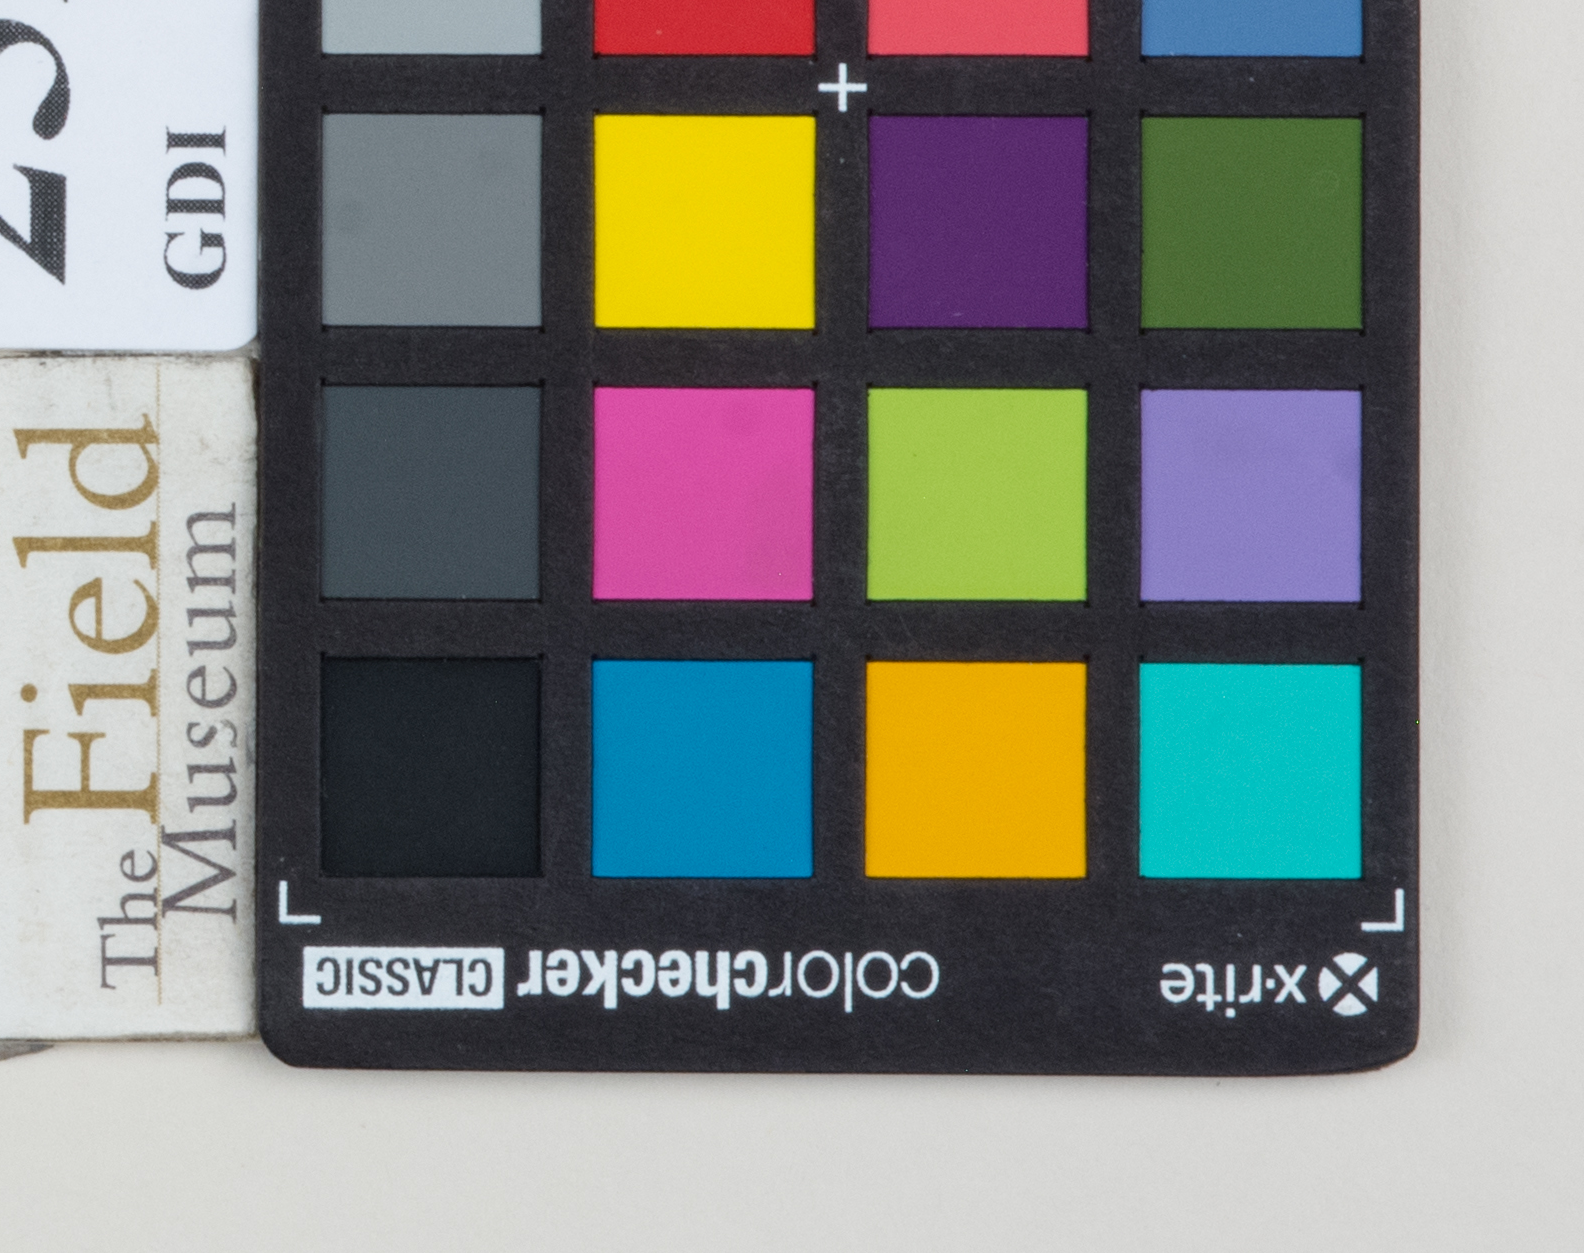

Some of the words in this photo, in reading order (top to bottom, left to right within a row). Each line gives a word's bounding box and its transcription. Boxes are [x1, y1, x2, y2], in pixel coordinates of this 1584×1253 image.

[163, 125, 228, 291] GDI
[12, 412, 160, 825] Field
[159, 501, 238, 923] Museum
[96, 848, 160, 990] The
[315, 955, 494, 997] CLASSIC
[516, 948, 940, 1013] colorchecker
